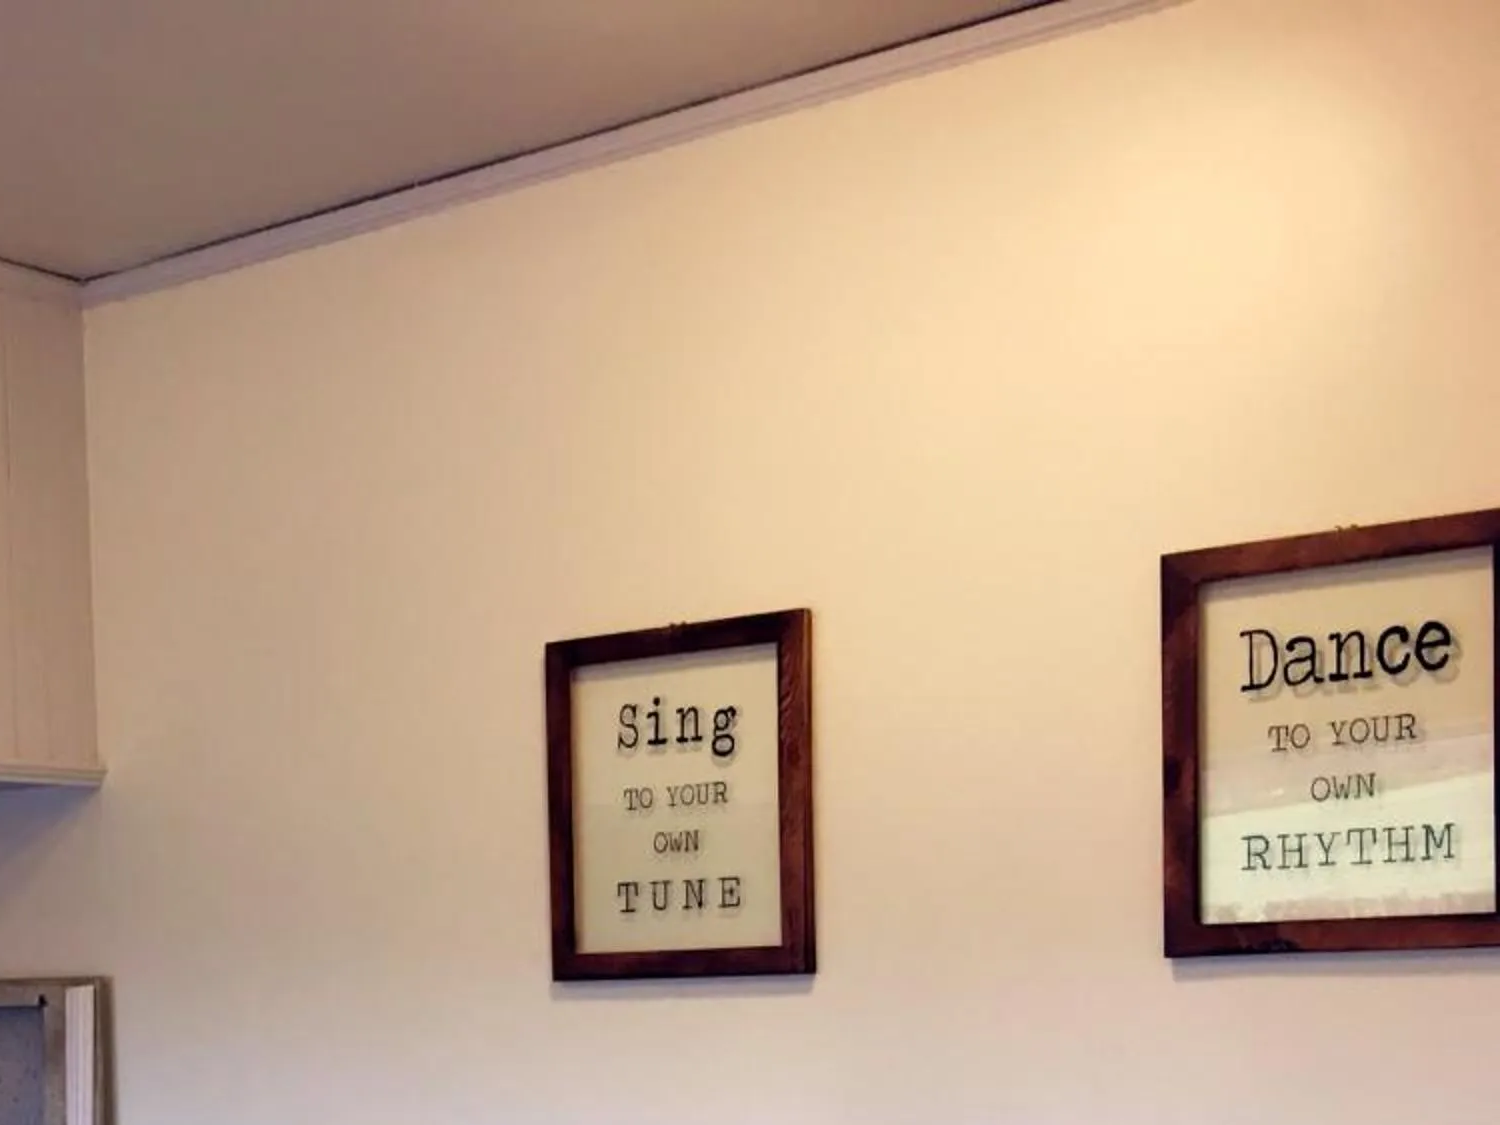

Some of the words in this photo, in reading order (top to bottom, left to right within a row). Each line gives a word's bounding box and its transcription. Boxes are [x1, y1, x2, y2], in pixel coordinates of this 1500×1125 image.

[1239, 618, 1452, 692] Dance
[617, 697, 738, 757] Sing
[1267, 723, 1311, 752] TO
[1331, 713, 1417, 746] YOUR
[623, 787, 653, 811] TO
[666, 781, 729, 808] YOUR
[1310, 773, 1376, 801] OWN
[653, 830, 700, 853] OWN
[1240, 823, 1455, 871] RHYTHM
[617, 876, 741, 913] TUNE
